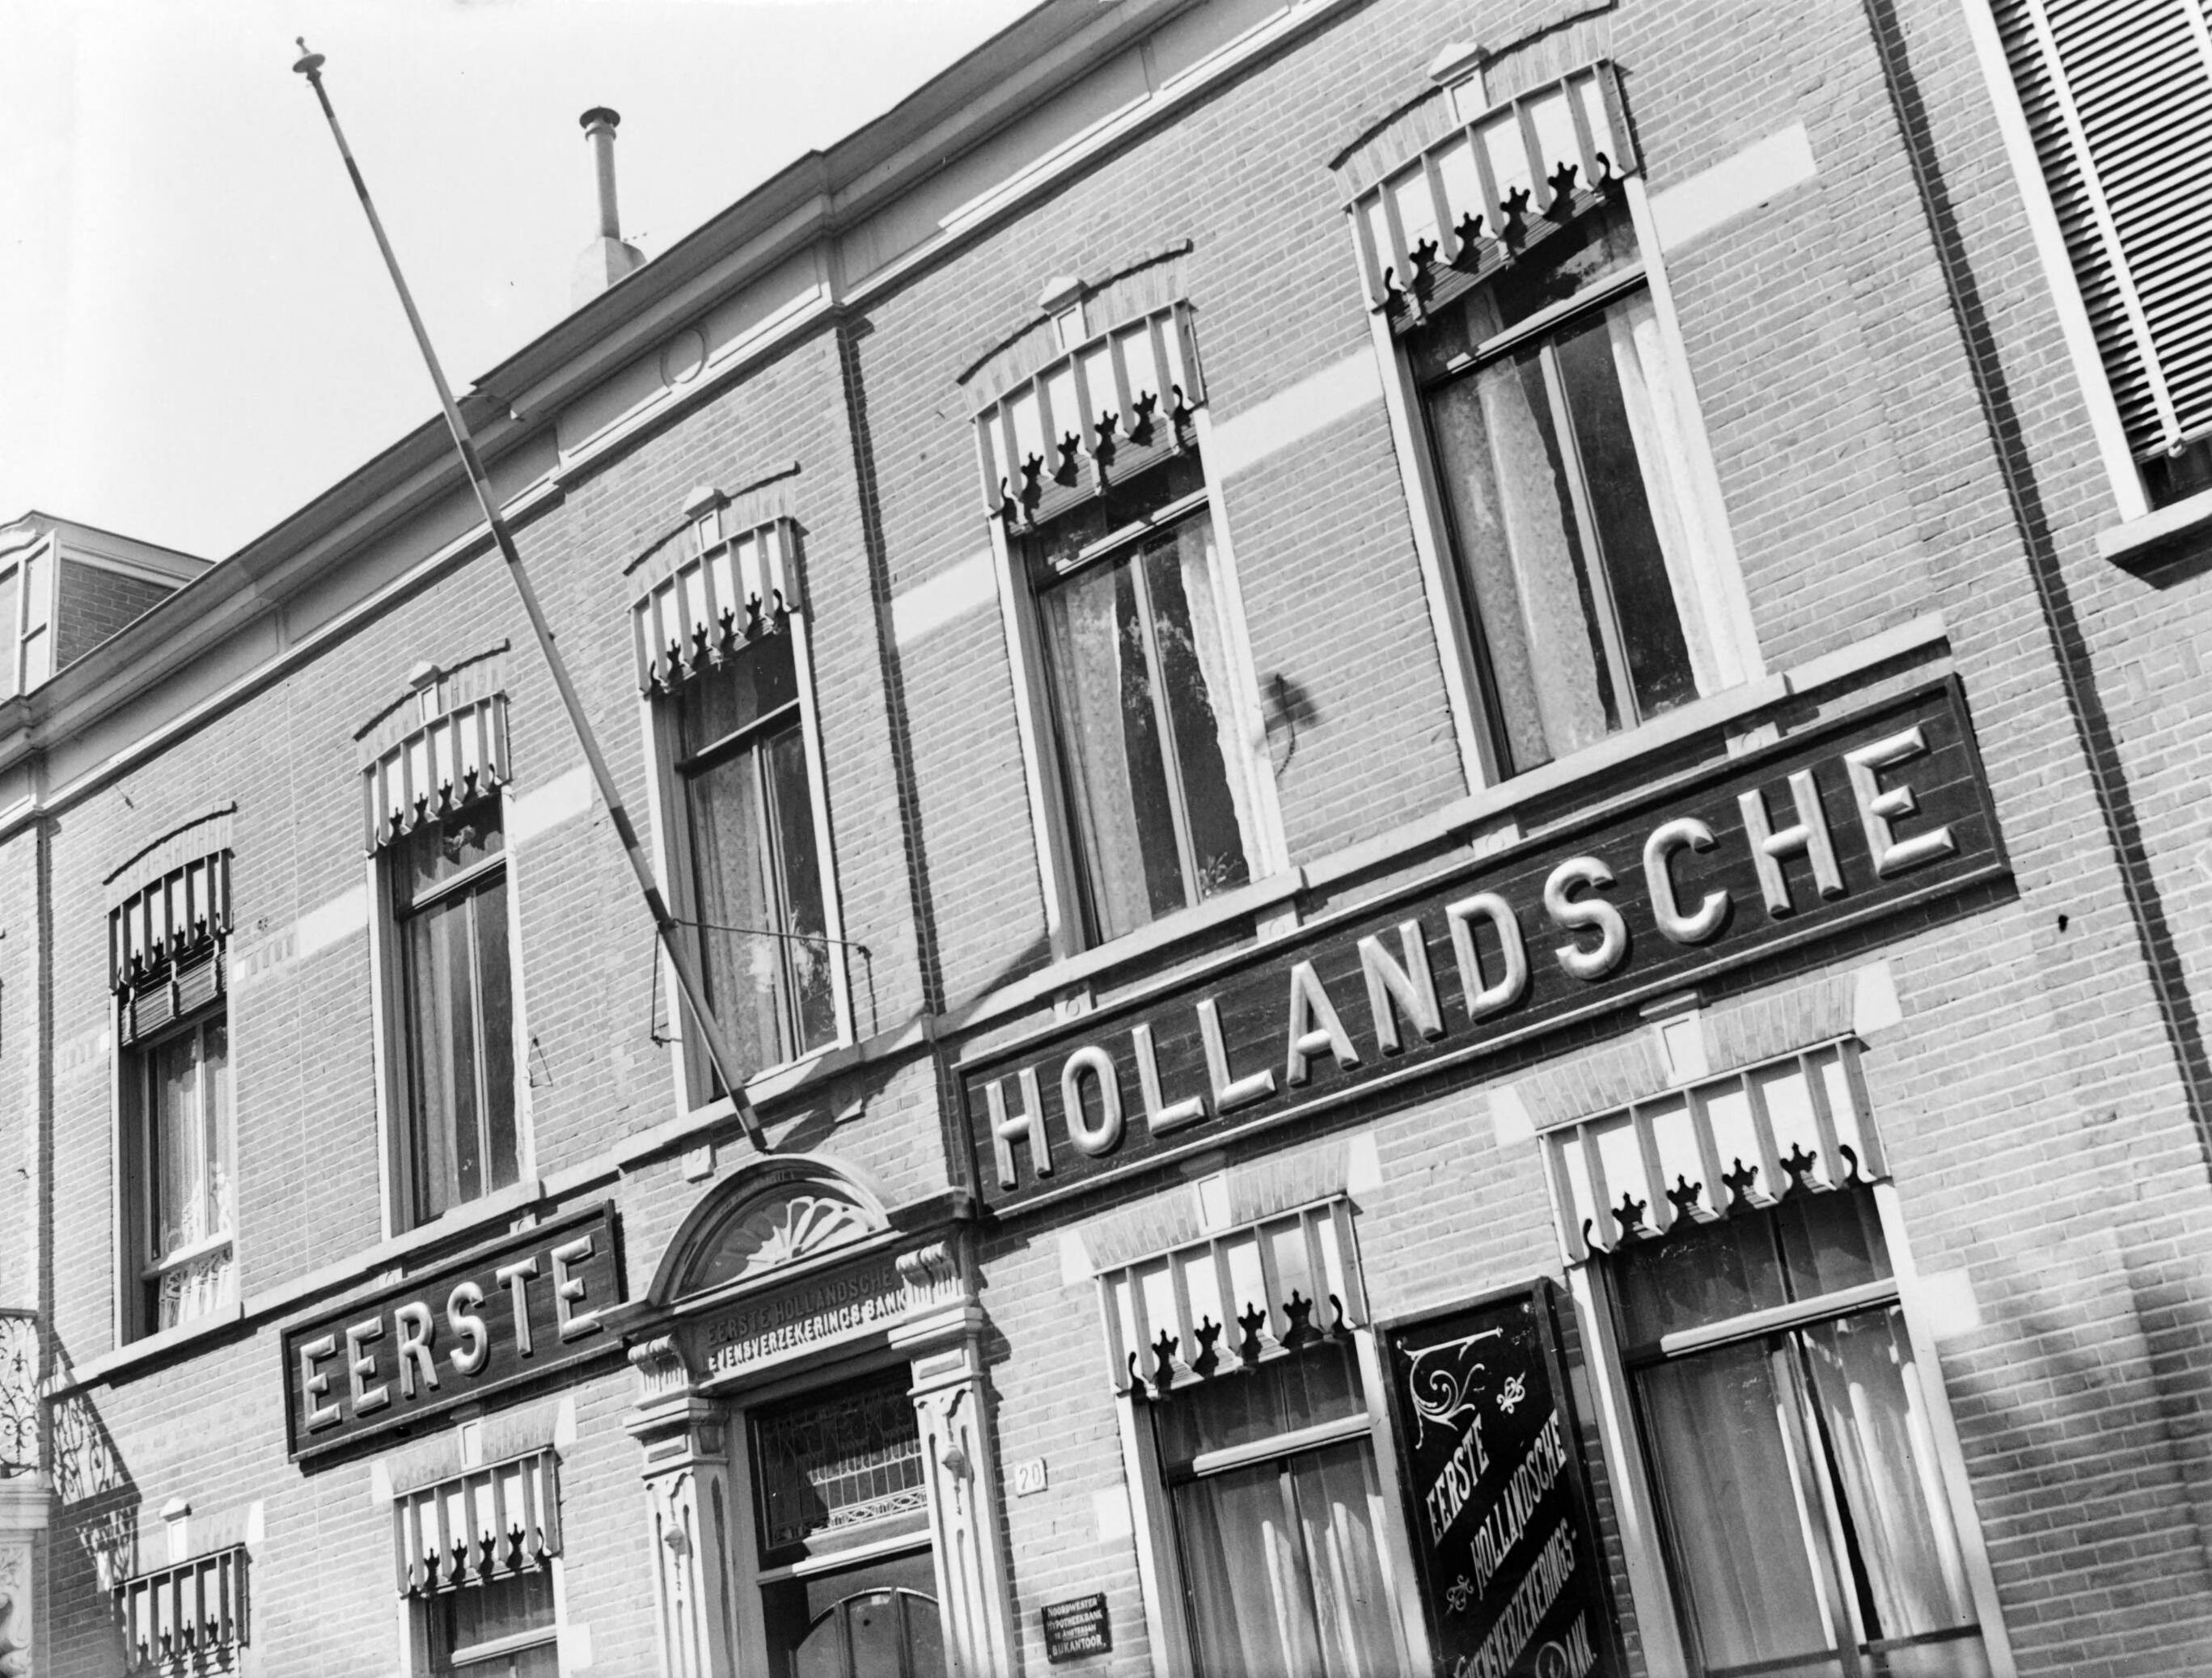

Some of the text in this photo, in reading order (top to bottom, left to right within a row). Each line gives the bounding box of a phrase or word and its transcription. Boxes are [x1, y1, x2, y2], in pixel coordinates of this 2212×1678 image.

[985, 725, 1956, 1190] HOLLANDSCHE
[300, 1234, 604, 1434] EERSTE
[708, 1269, 893, 1347] EERSTE HOLLANDSCHE
[864, 1288, 907, 1321] BANK
[1019, 1463, 1042, 1490] 20
[1425, 1412, 1489, 1547] EERSTE
[1470, 1408, 1567, 1601] HOLLANDSCHE
[1453, 1517, 1577, 1678] ENSVERZEKERINGS-
